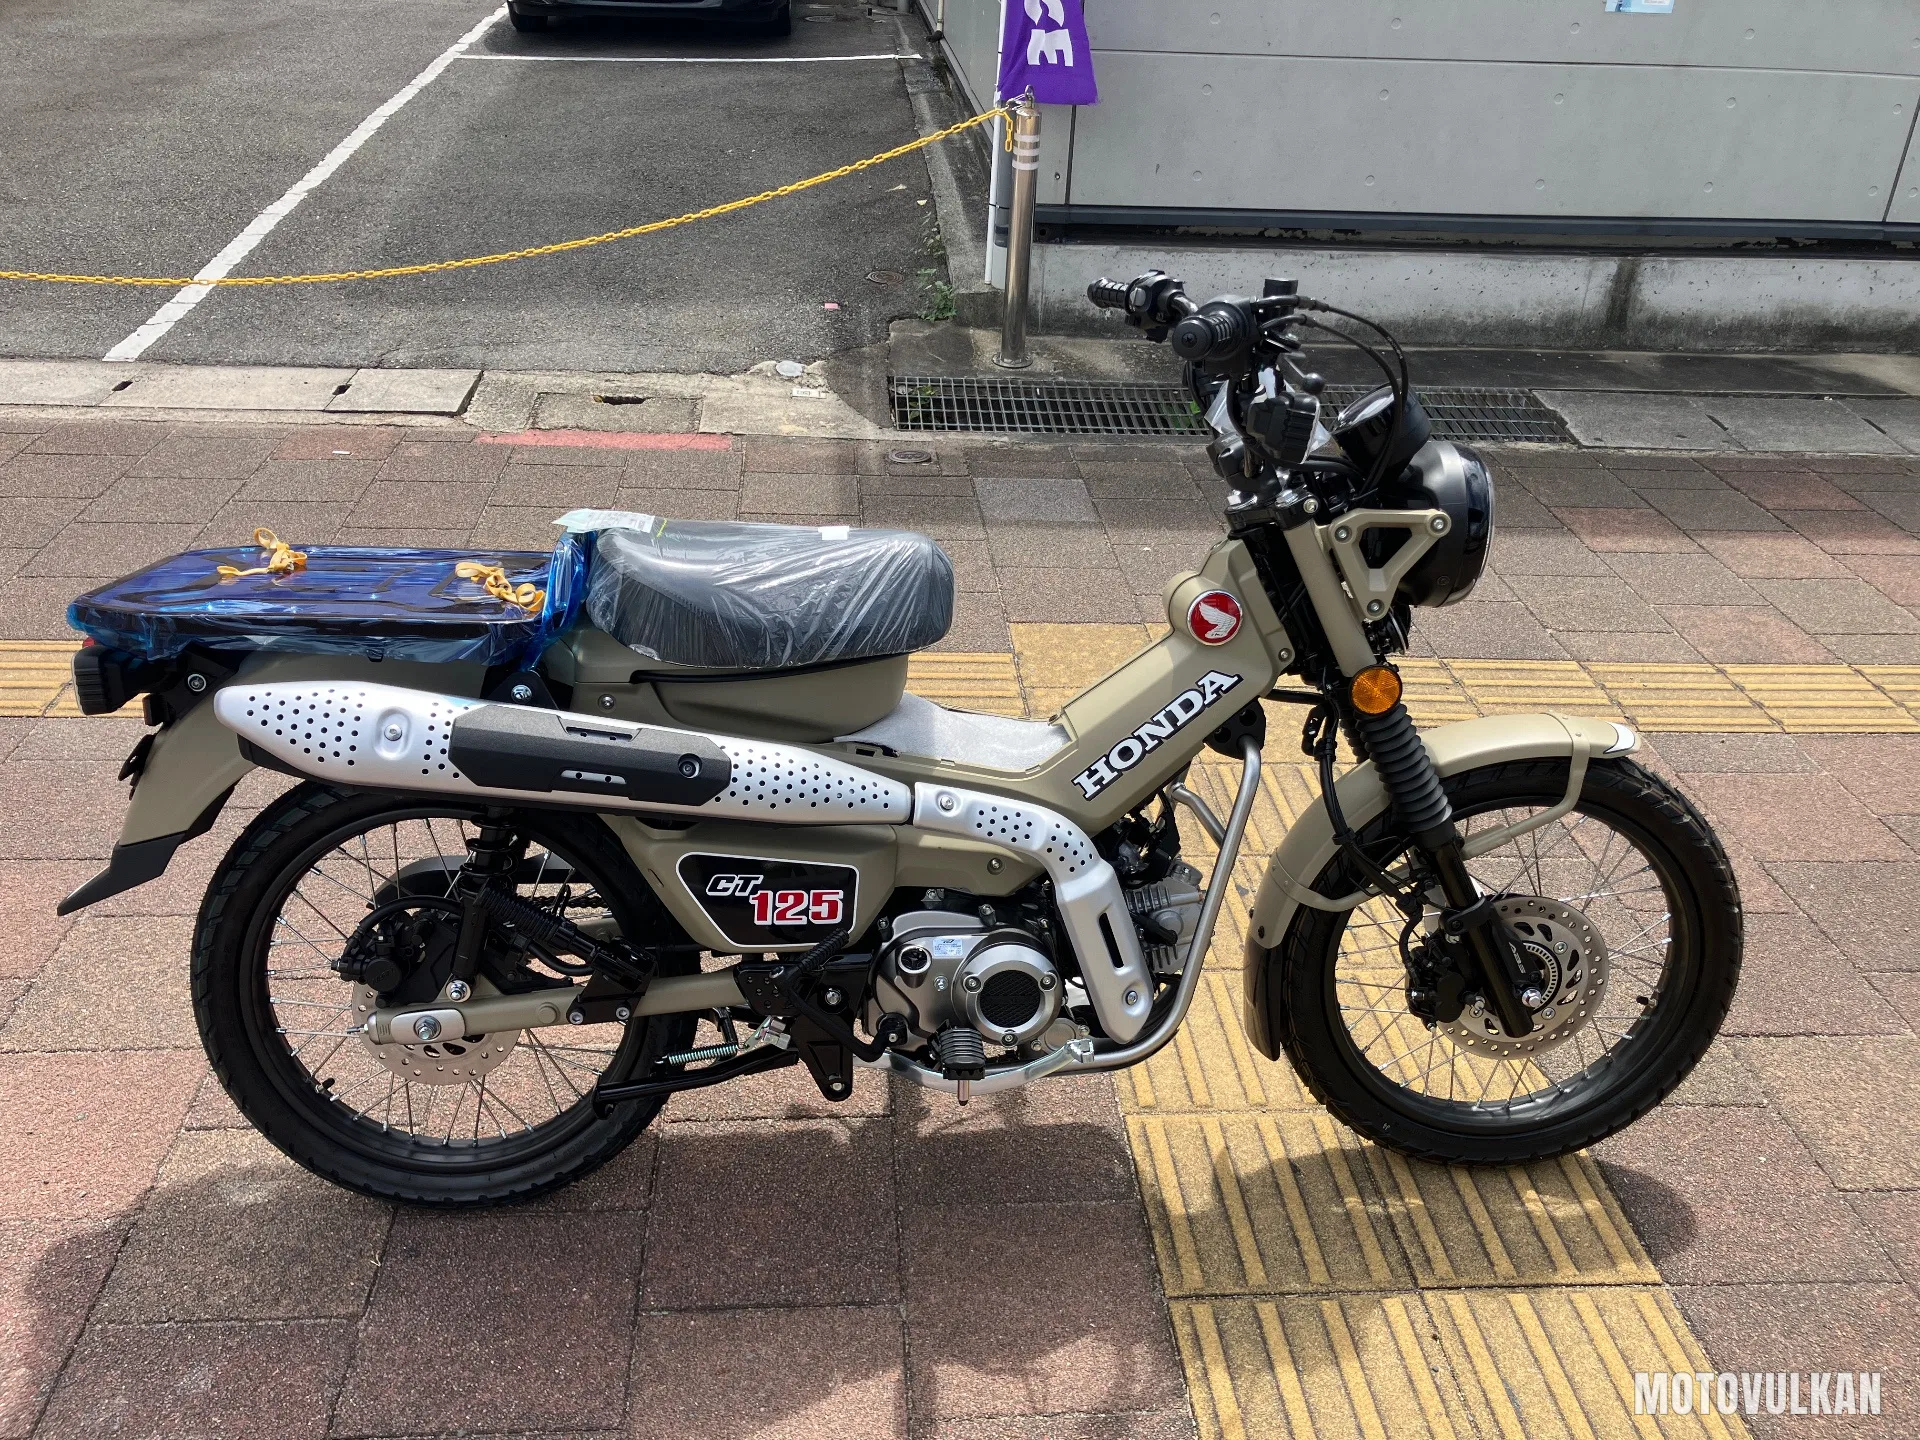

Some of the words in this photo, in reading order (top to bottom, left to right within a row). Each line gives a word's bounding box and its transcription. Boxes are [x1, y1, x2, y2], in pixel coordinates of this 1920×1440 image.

[1071, 669, 1244, 801] HONDA
[705, 874, 764, 896] CT
[749, 890, 843, 925] 125
